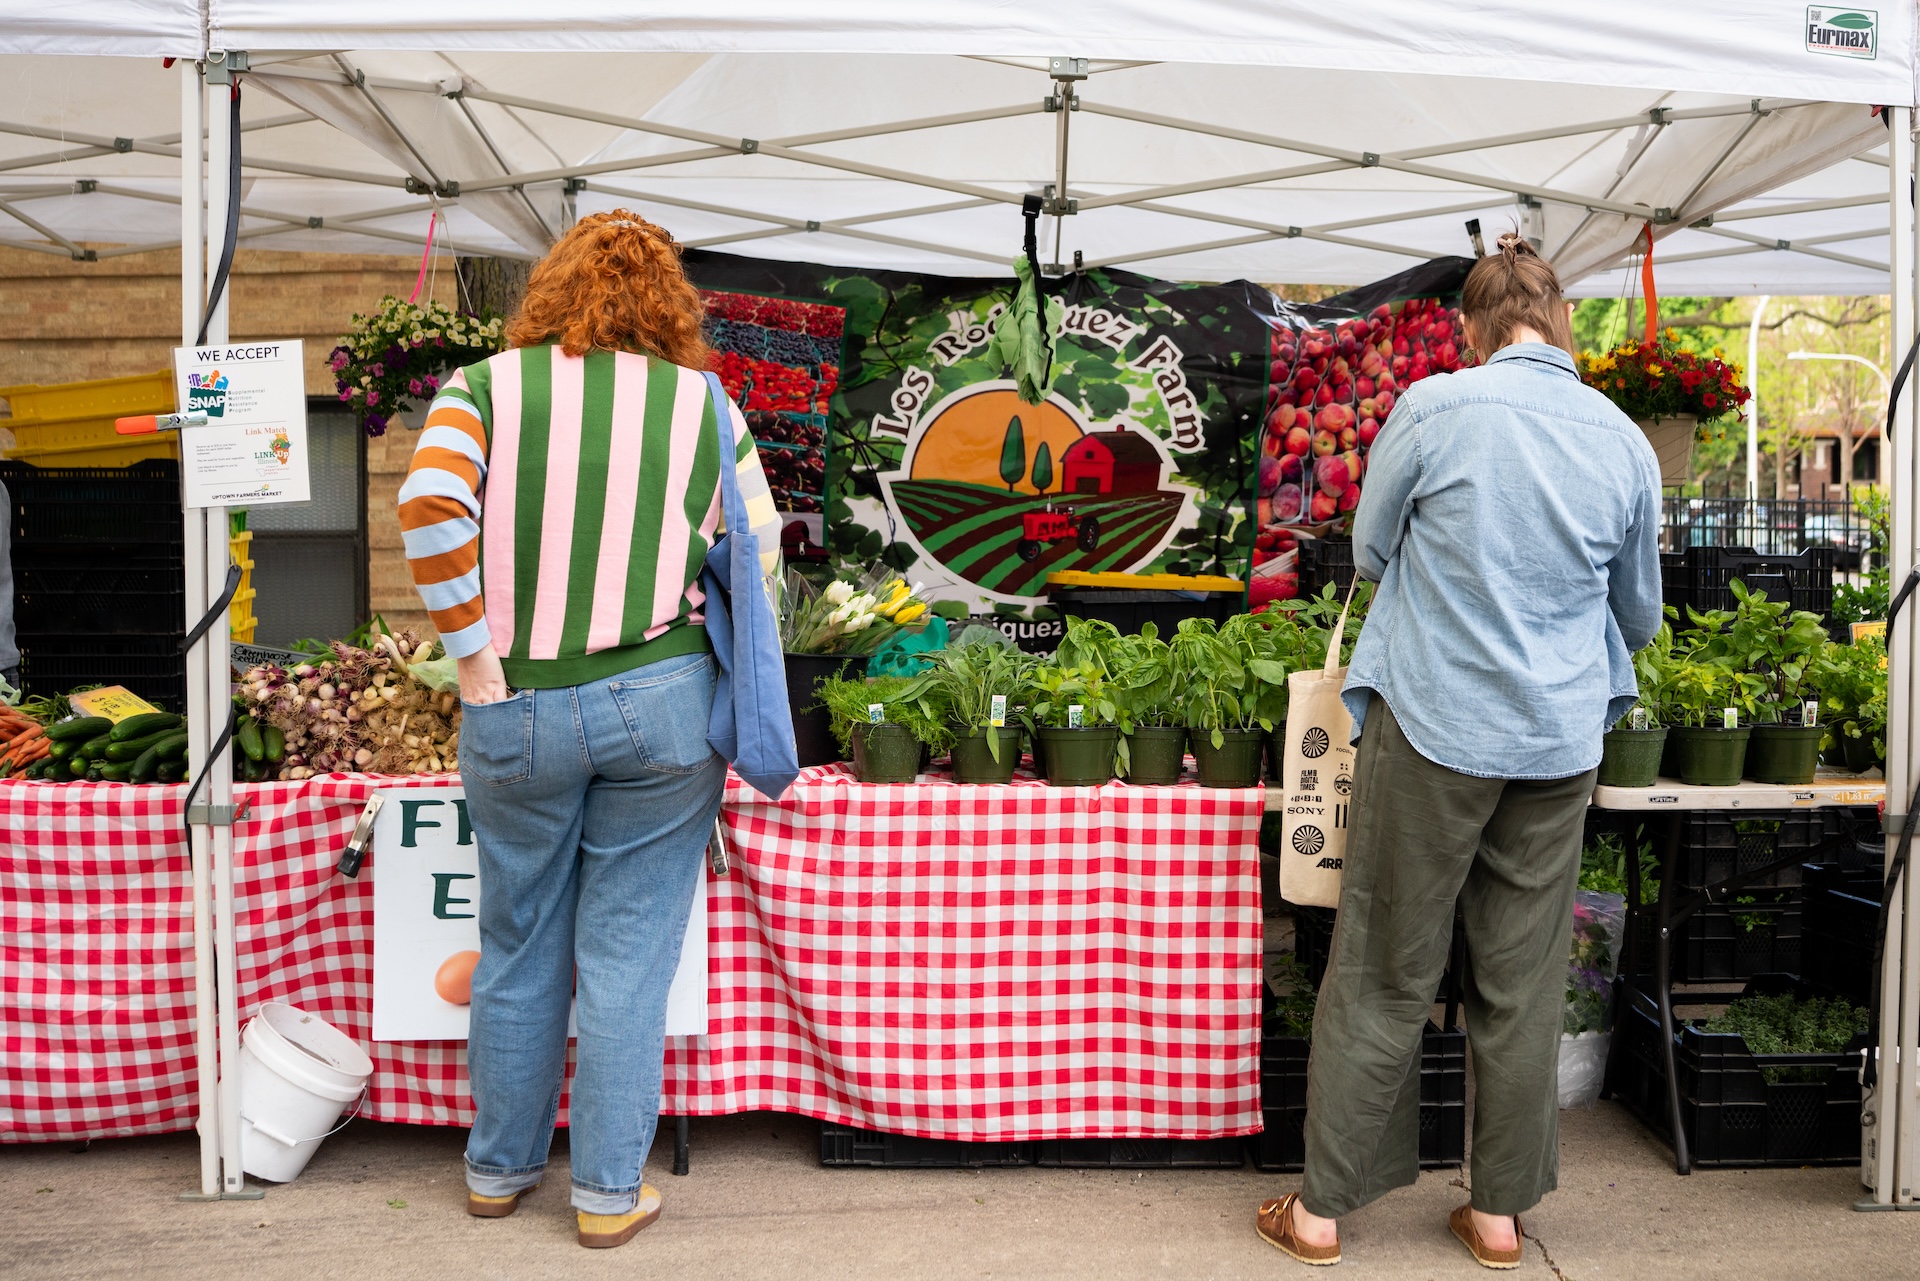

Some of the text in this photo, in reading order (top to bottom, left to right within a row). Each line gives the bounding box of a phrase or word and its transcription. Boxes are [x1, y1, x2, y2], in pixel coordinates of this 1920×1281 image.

[1808, 24, 1870, 48] Eurmax
[197, 346, 280, 362] WE ACCEPT
[228, 388, 266, 396] Supplemental
[876, 371, 930, 439] Los
[1133, 340, 1200, 449] Farm
[188, 395, 226, 409] SNAP
[245, 426, 287, 436] Link Match
[254, 451, 276, 459] LINK
[1300, 783, 1316, 791] TIMES
[1287, 806, 1326, 816] SONY
